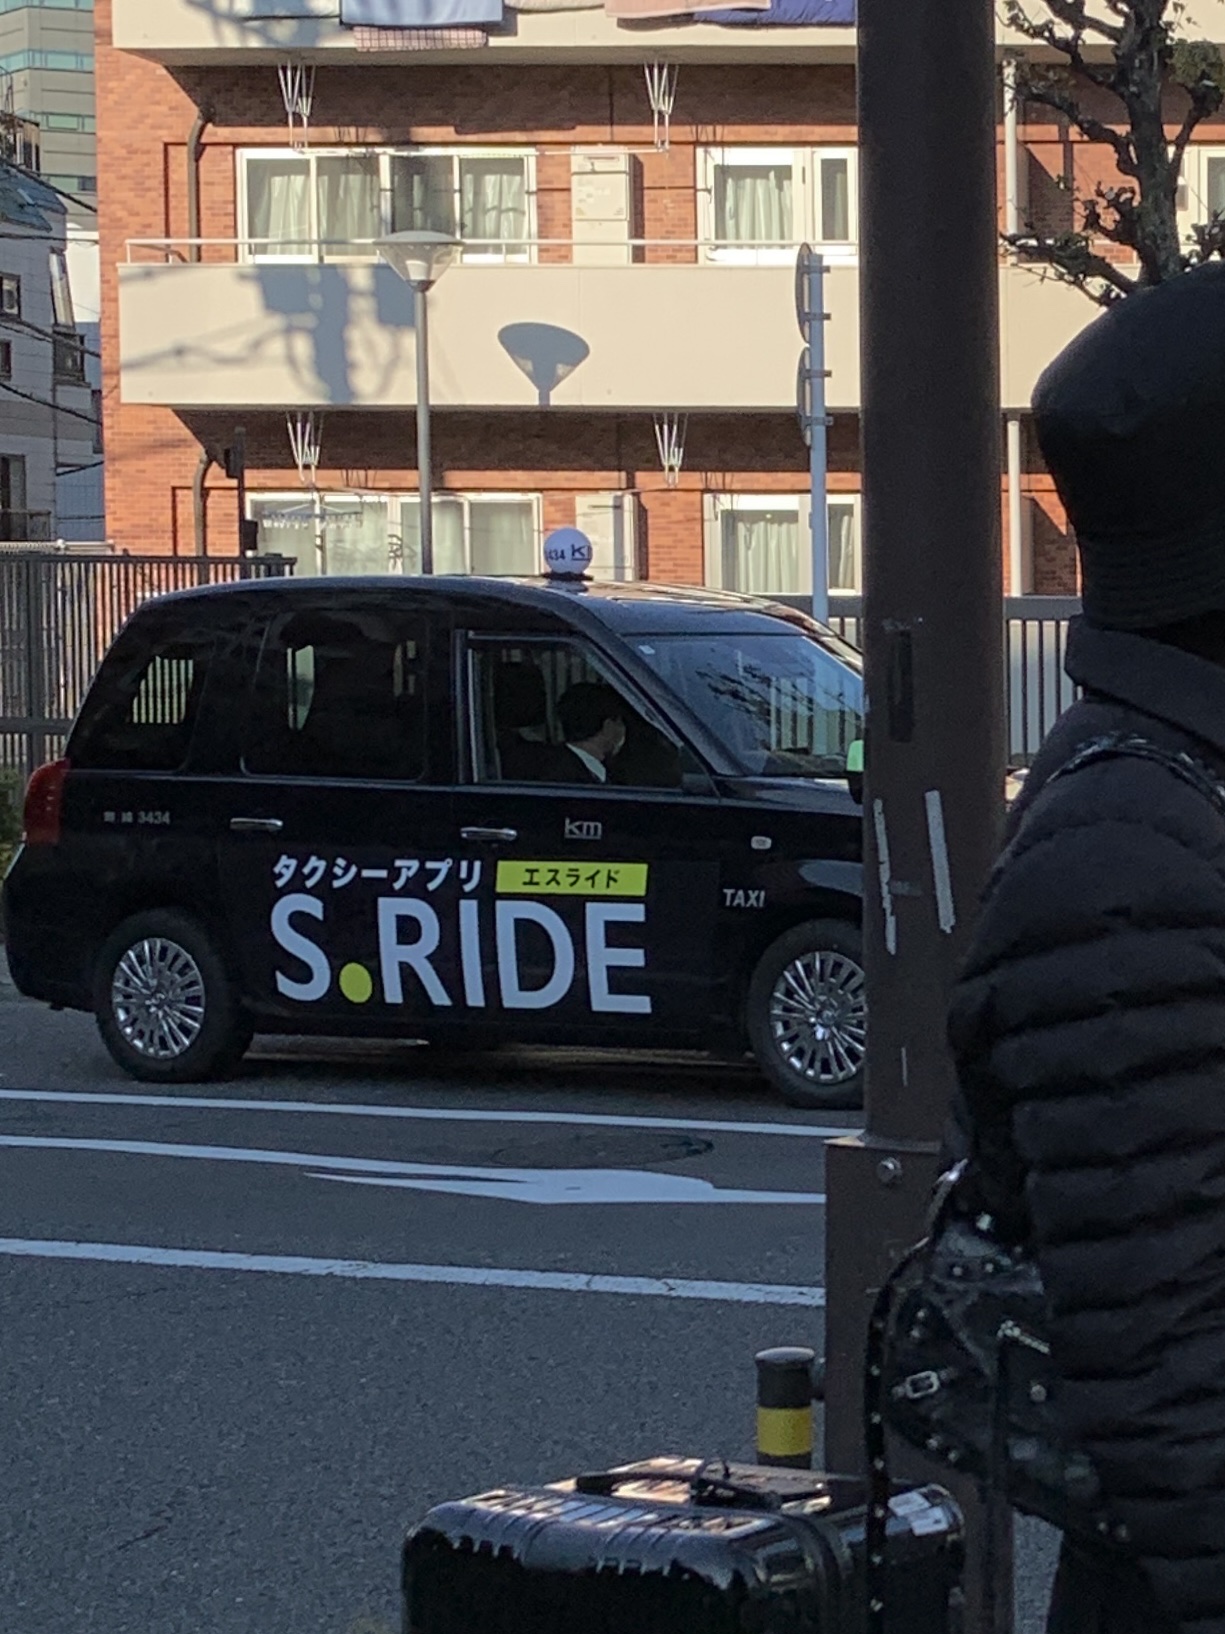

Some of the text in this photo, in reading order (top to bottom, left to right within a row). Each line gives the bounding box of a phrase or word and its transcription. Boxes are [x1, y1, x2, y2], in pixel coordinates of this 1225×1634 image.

[138, 810, 170, 825] 3434
[272, 854, 482, 892] タクシーアプリ
[522, 867, 621, 889] エスライド
[722, 888, 766, 908] TAXI
[271, 893, 652, 1013] S.RIDE
